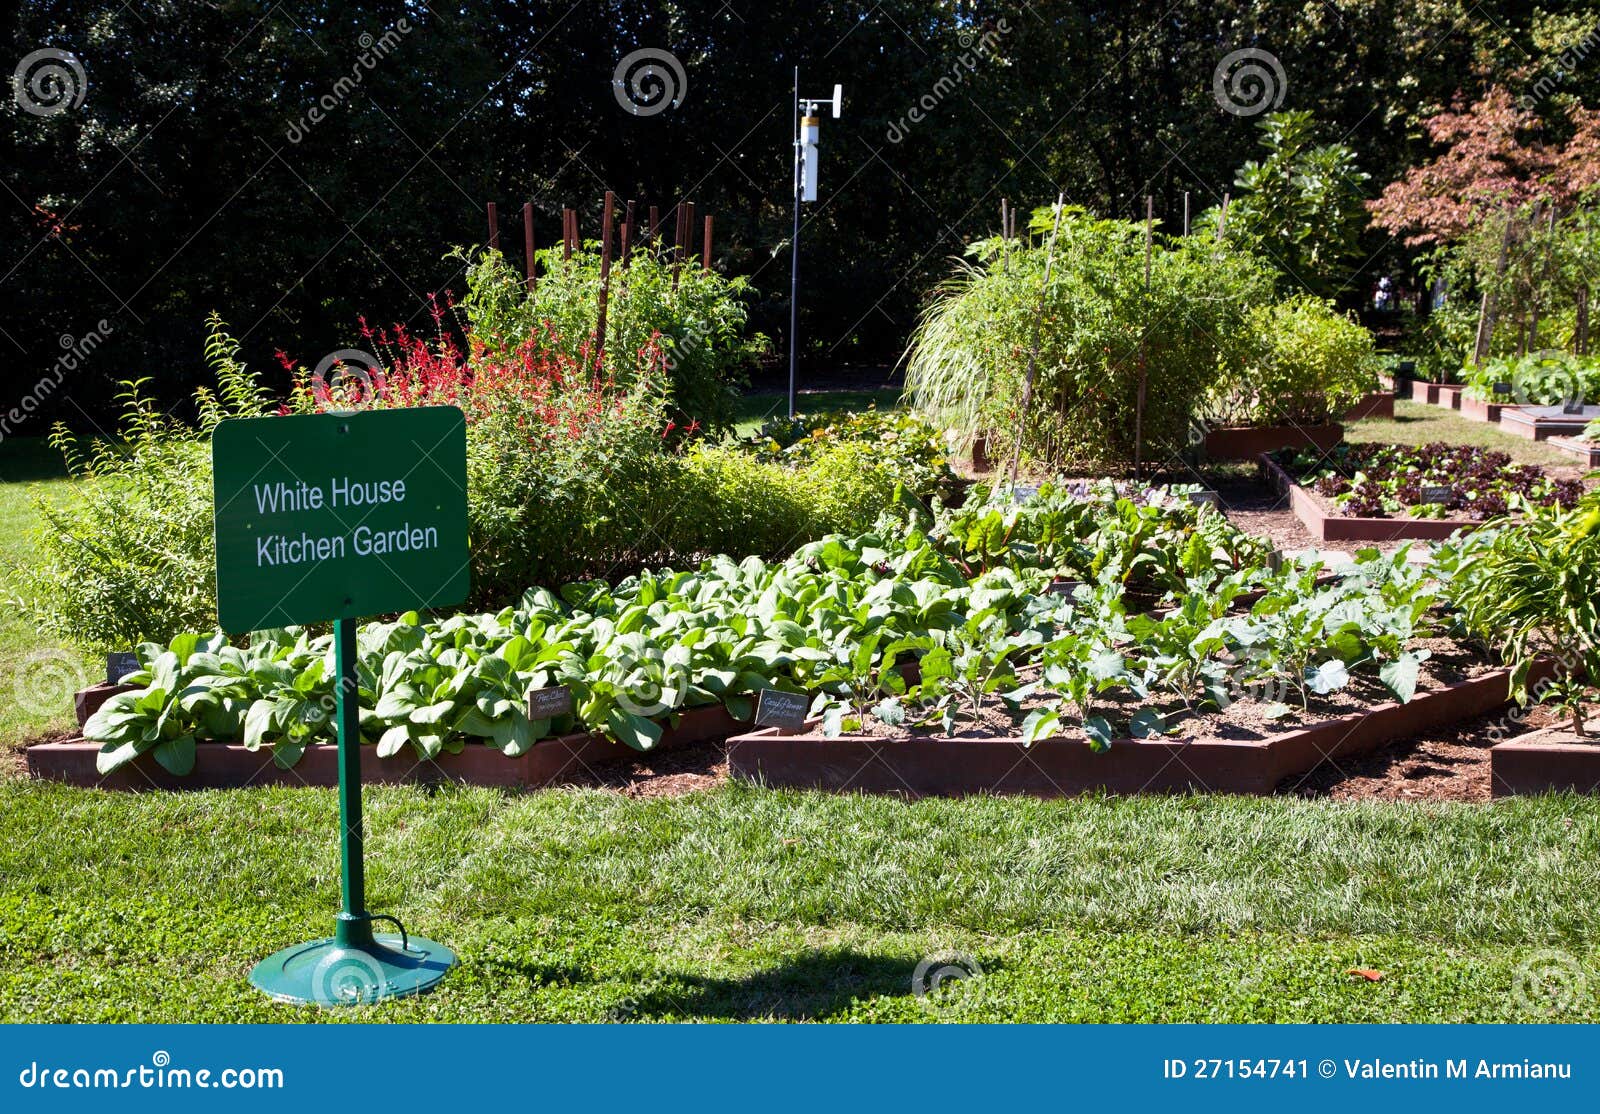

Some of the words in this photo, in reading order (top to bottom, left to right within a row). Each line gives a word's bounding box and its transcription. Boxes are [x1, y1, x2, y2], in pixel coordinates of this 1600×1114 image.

[254, 481, 324, 515] White
[331, 476, 406, 508] House
[257, 532, 345, 567] Kitchen
[353, 522, 438, 556] Garden
